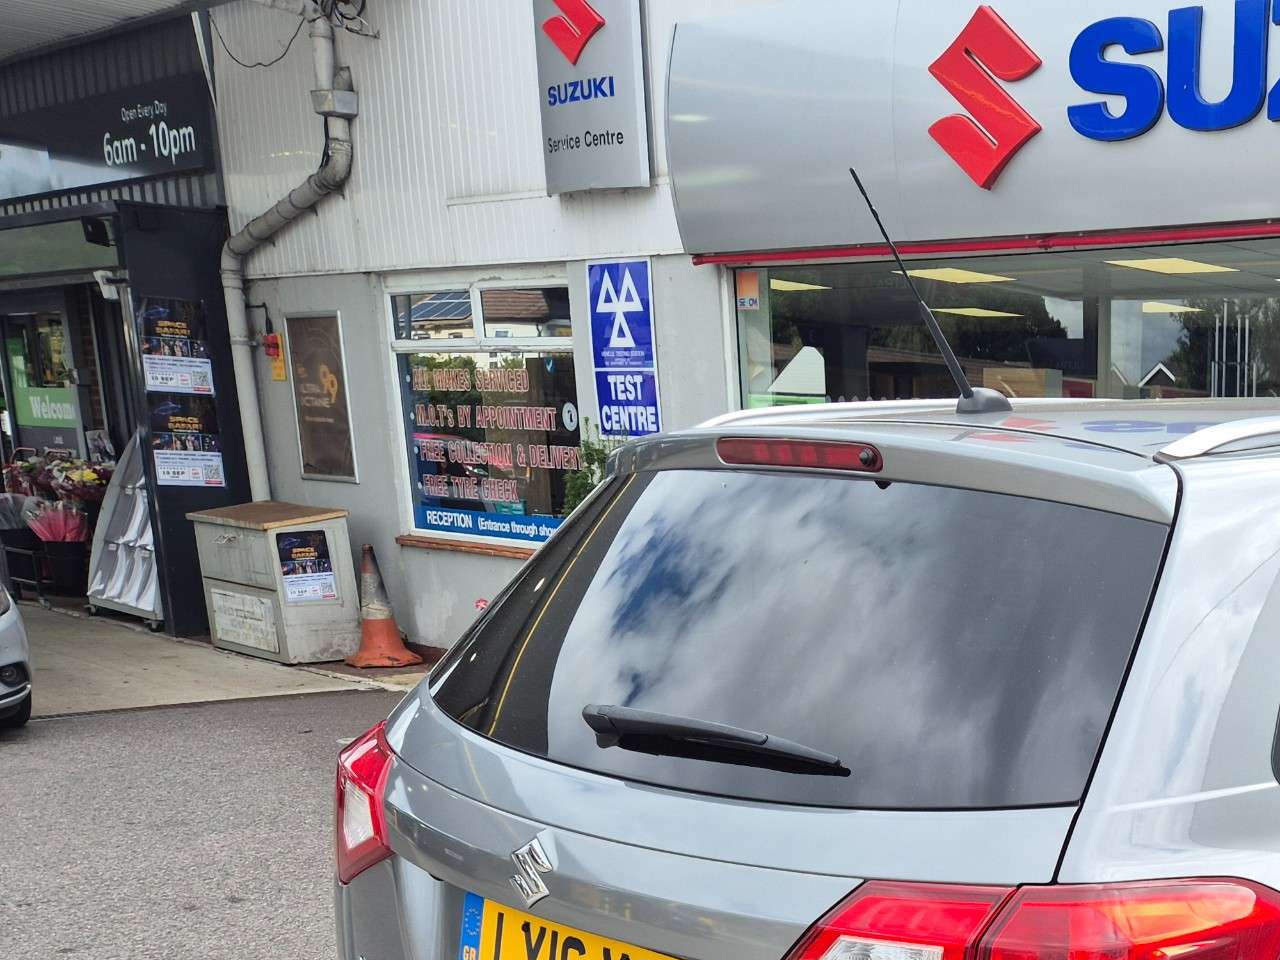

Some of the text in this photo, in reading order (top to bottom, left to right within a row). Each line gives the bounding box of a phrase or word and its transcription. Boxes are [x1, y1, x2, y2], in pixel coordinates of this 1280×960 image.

[547, 76, 615, 106] SUZUKI
[121, 100, 167, 122] Open Every Day
[103, 132, 138, 166] 6am
[149, 120, 196, 165] 10pm
[547, 128, 624, 154] Service Centre
[413, 368, 529, 392] ALL MAKES SERVICED
[607, 374, 643, 401] TEST
[457, 404, 472, 428] BY
[476, 406, 557, 431] APPOINTMENT
[601, 404, 658, 432] CENTRE
[420, 439, 583, 471] FREE COLLECTION & DELIVERY
[423, 474, 520, 503] FREE TYRE CHECK
[426, 510, 473, 529] RECEPTION
[477, 516, 510, 534] (Entrance
[511, 520, 538, 538] through
